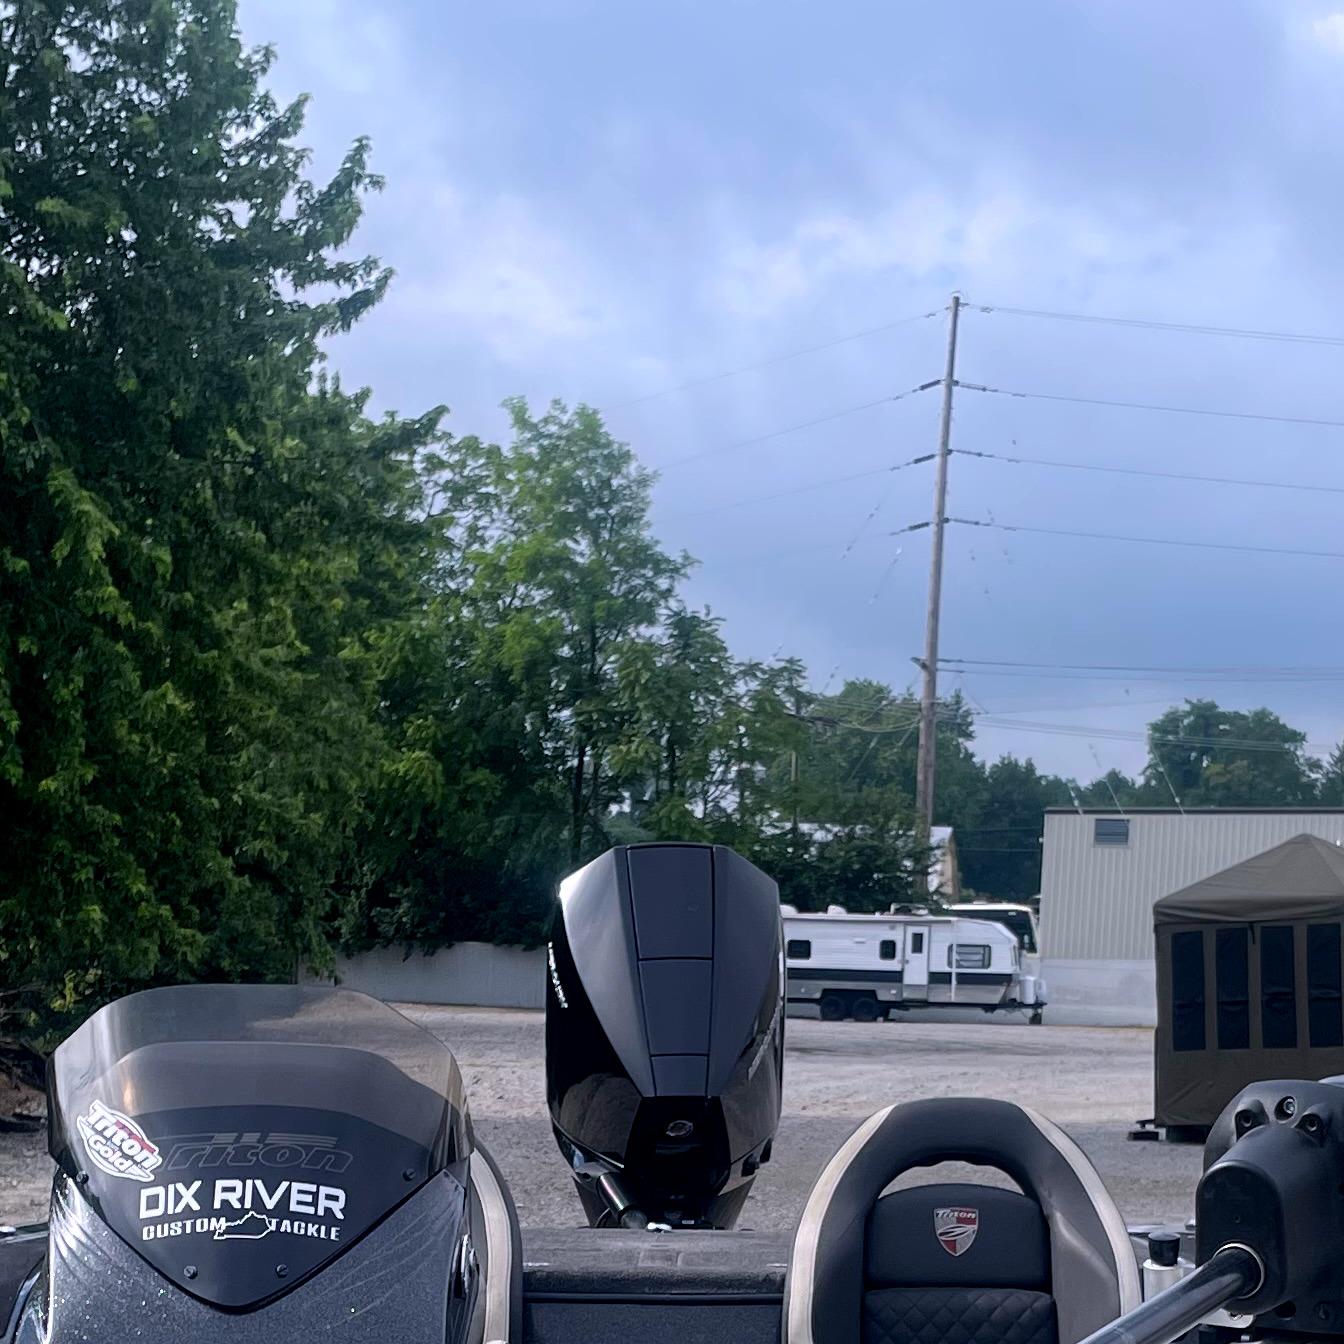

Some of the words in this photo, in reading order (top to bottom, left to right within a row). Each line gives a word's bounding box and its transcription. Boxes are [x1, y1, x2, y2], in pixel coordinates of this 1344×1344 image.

[86, 1103, 159, 1169] Triton
[88, 1134, 134, 1172] Gold
[139, 1180, 202, 1219] DIX
[213, 1179, 346, 1220] RIVER
[936, 1209, 976, 1219] Triton
[142, 1216, 227, 1241] CUSTOM
[268, 1217, 341, 1241] TACKLE
